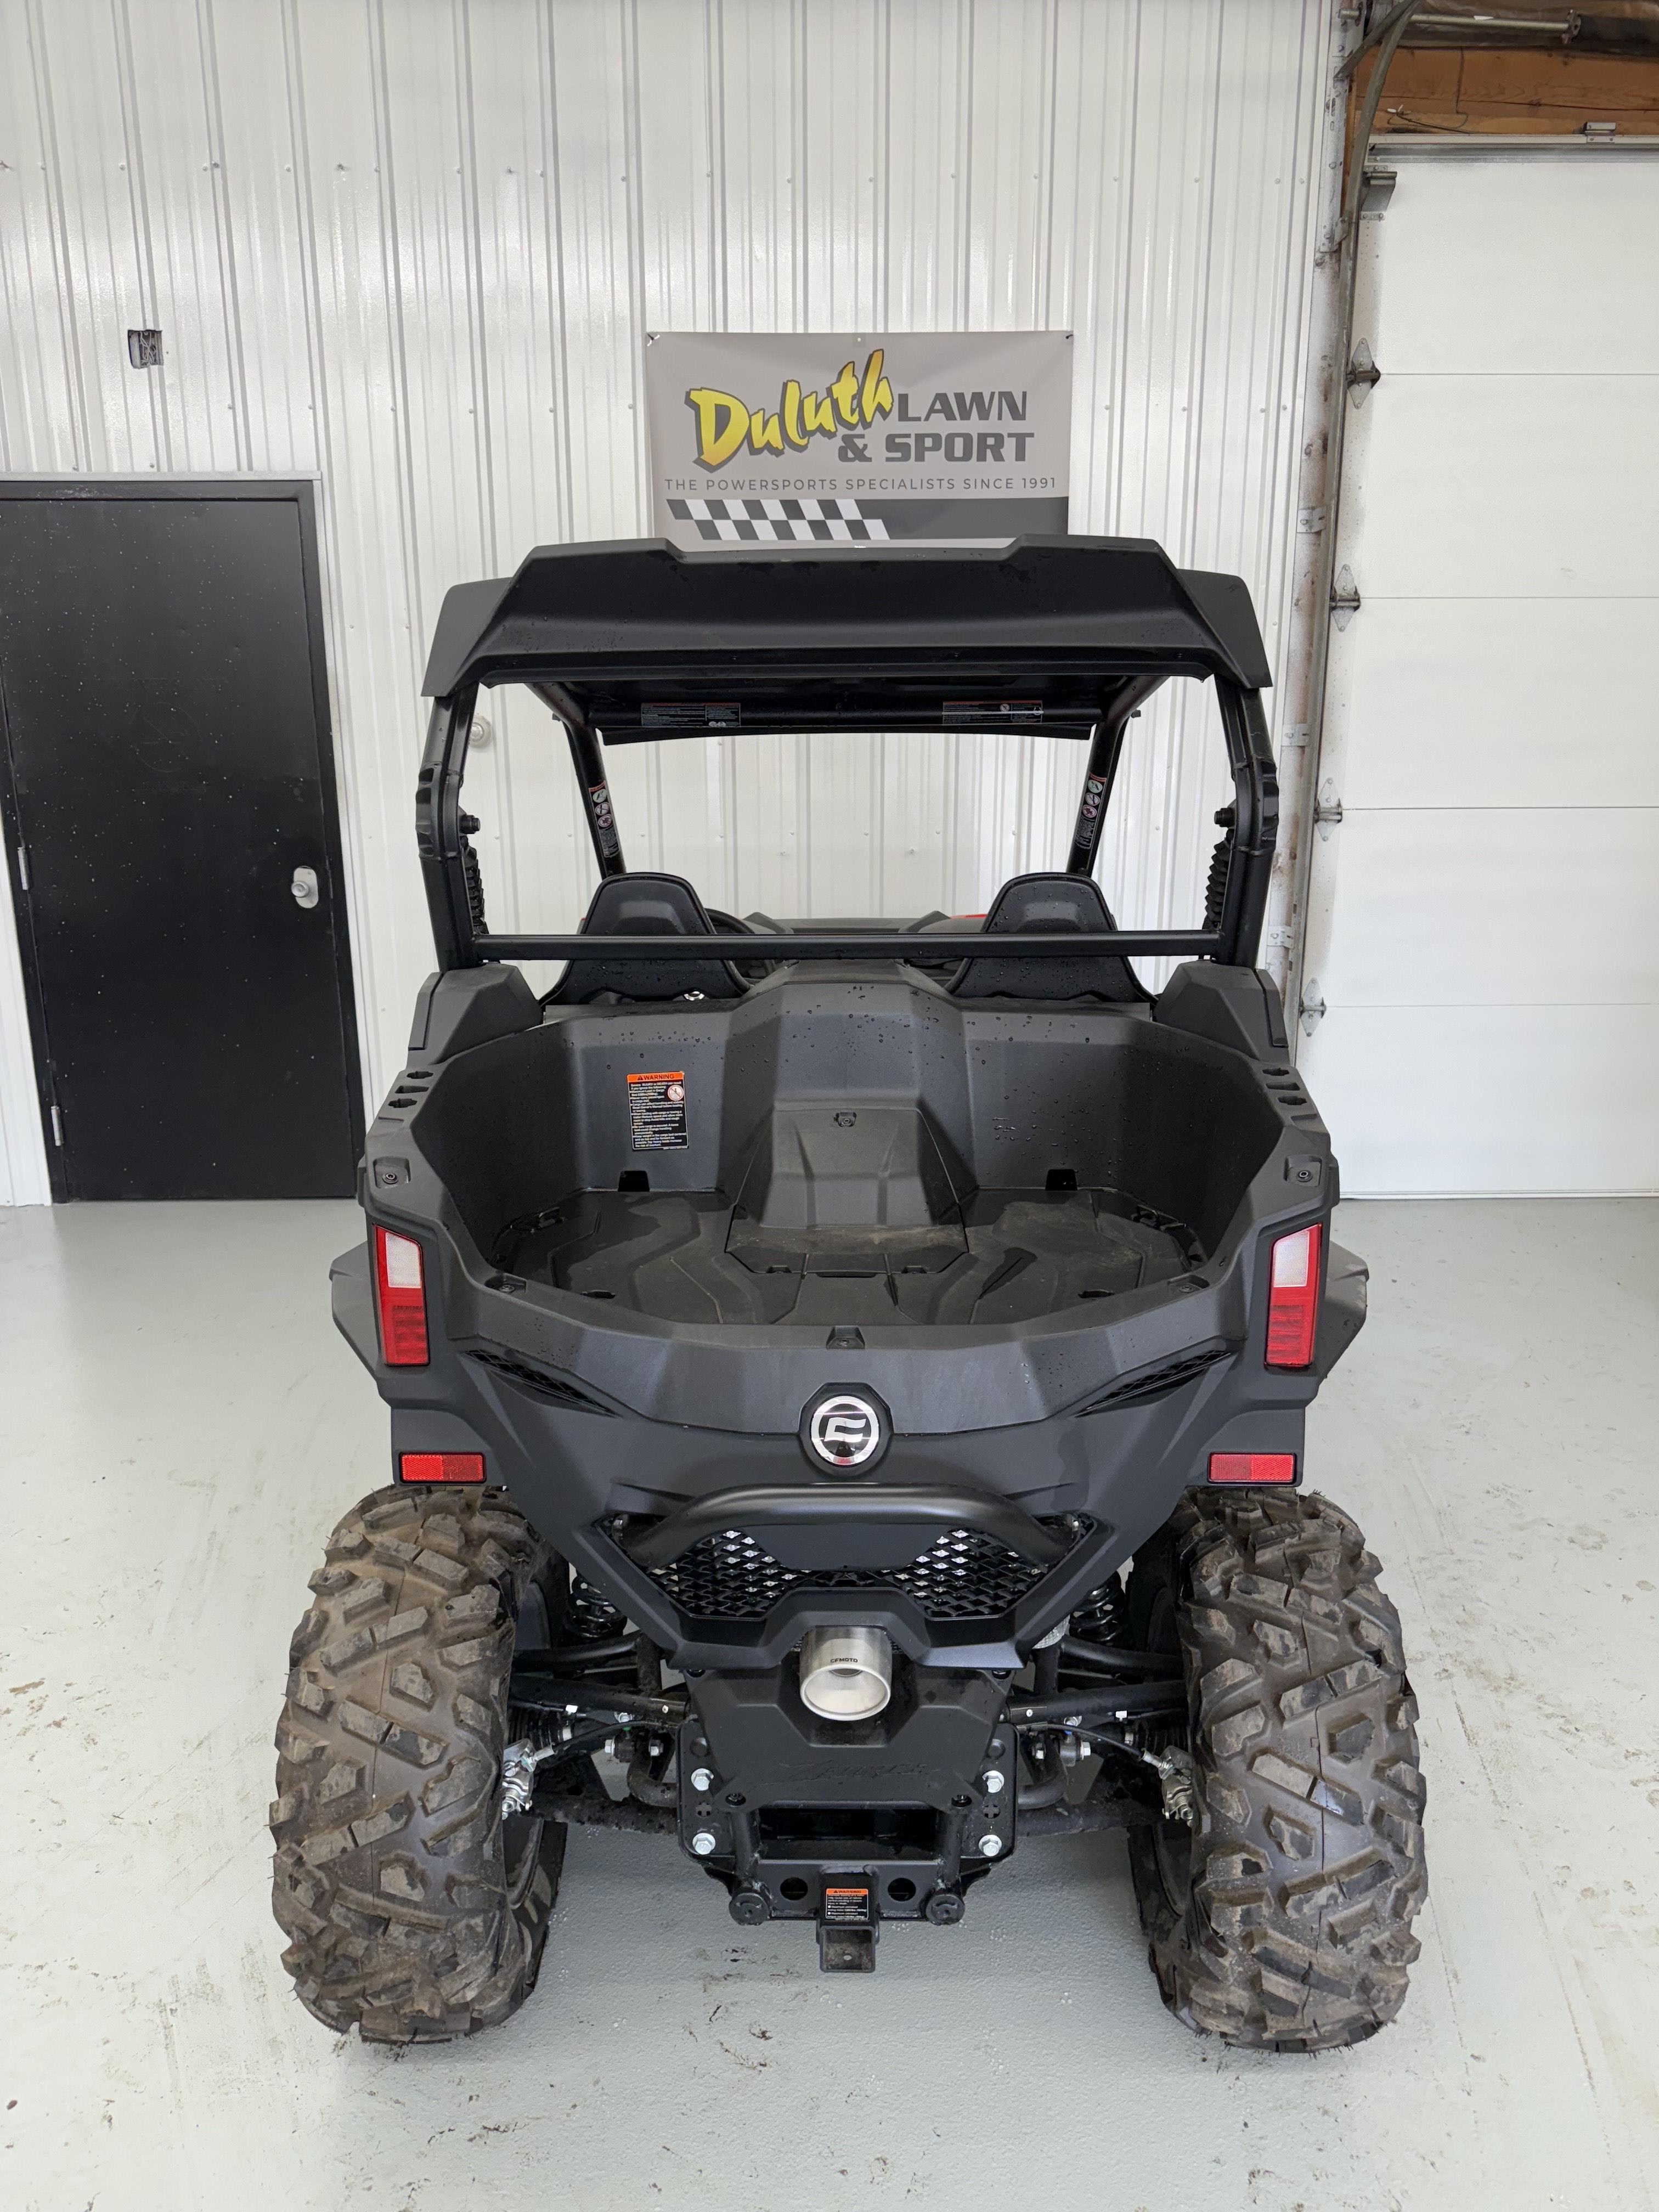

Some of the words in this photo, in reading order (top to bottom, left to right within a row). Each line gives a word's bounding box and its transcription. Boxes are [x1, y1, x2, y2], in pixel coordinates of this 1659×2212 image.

[684, 348, 894, 473] Duluth
[898, 391, 1027, 422] LAWN
[838, 433, 872, 462] &
[885, 432, 1035, 462] SPORT
[665, 479, 697, 490] THE
[706, 479, 837, 490] POWERSPORTS
[845, 478, 955, 490] SPECIALISTS
[963, 478, 1014, 489] SINCE
[1022, 477, 1056, 489] 1991
